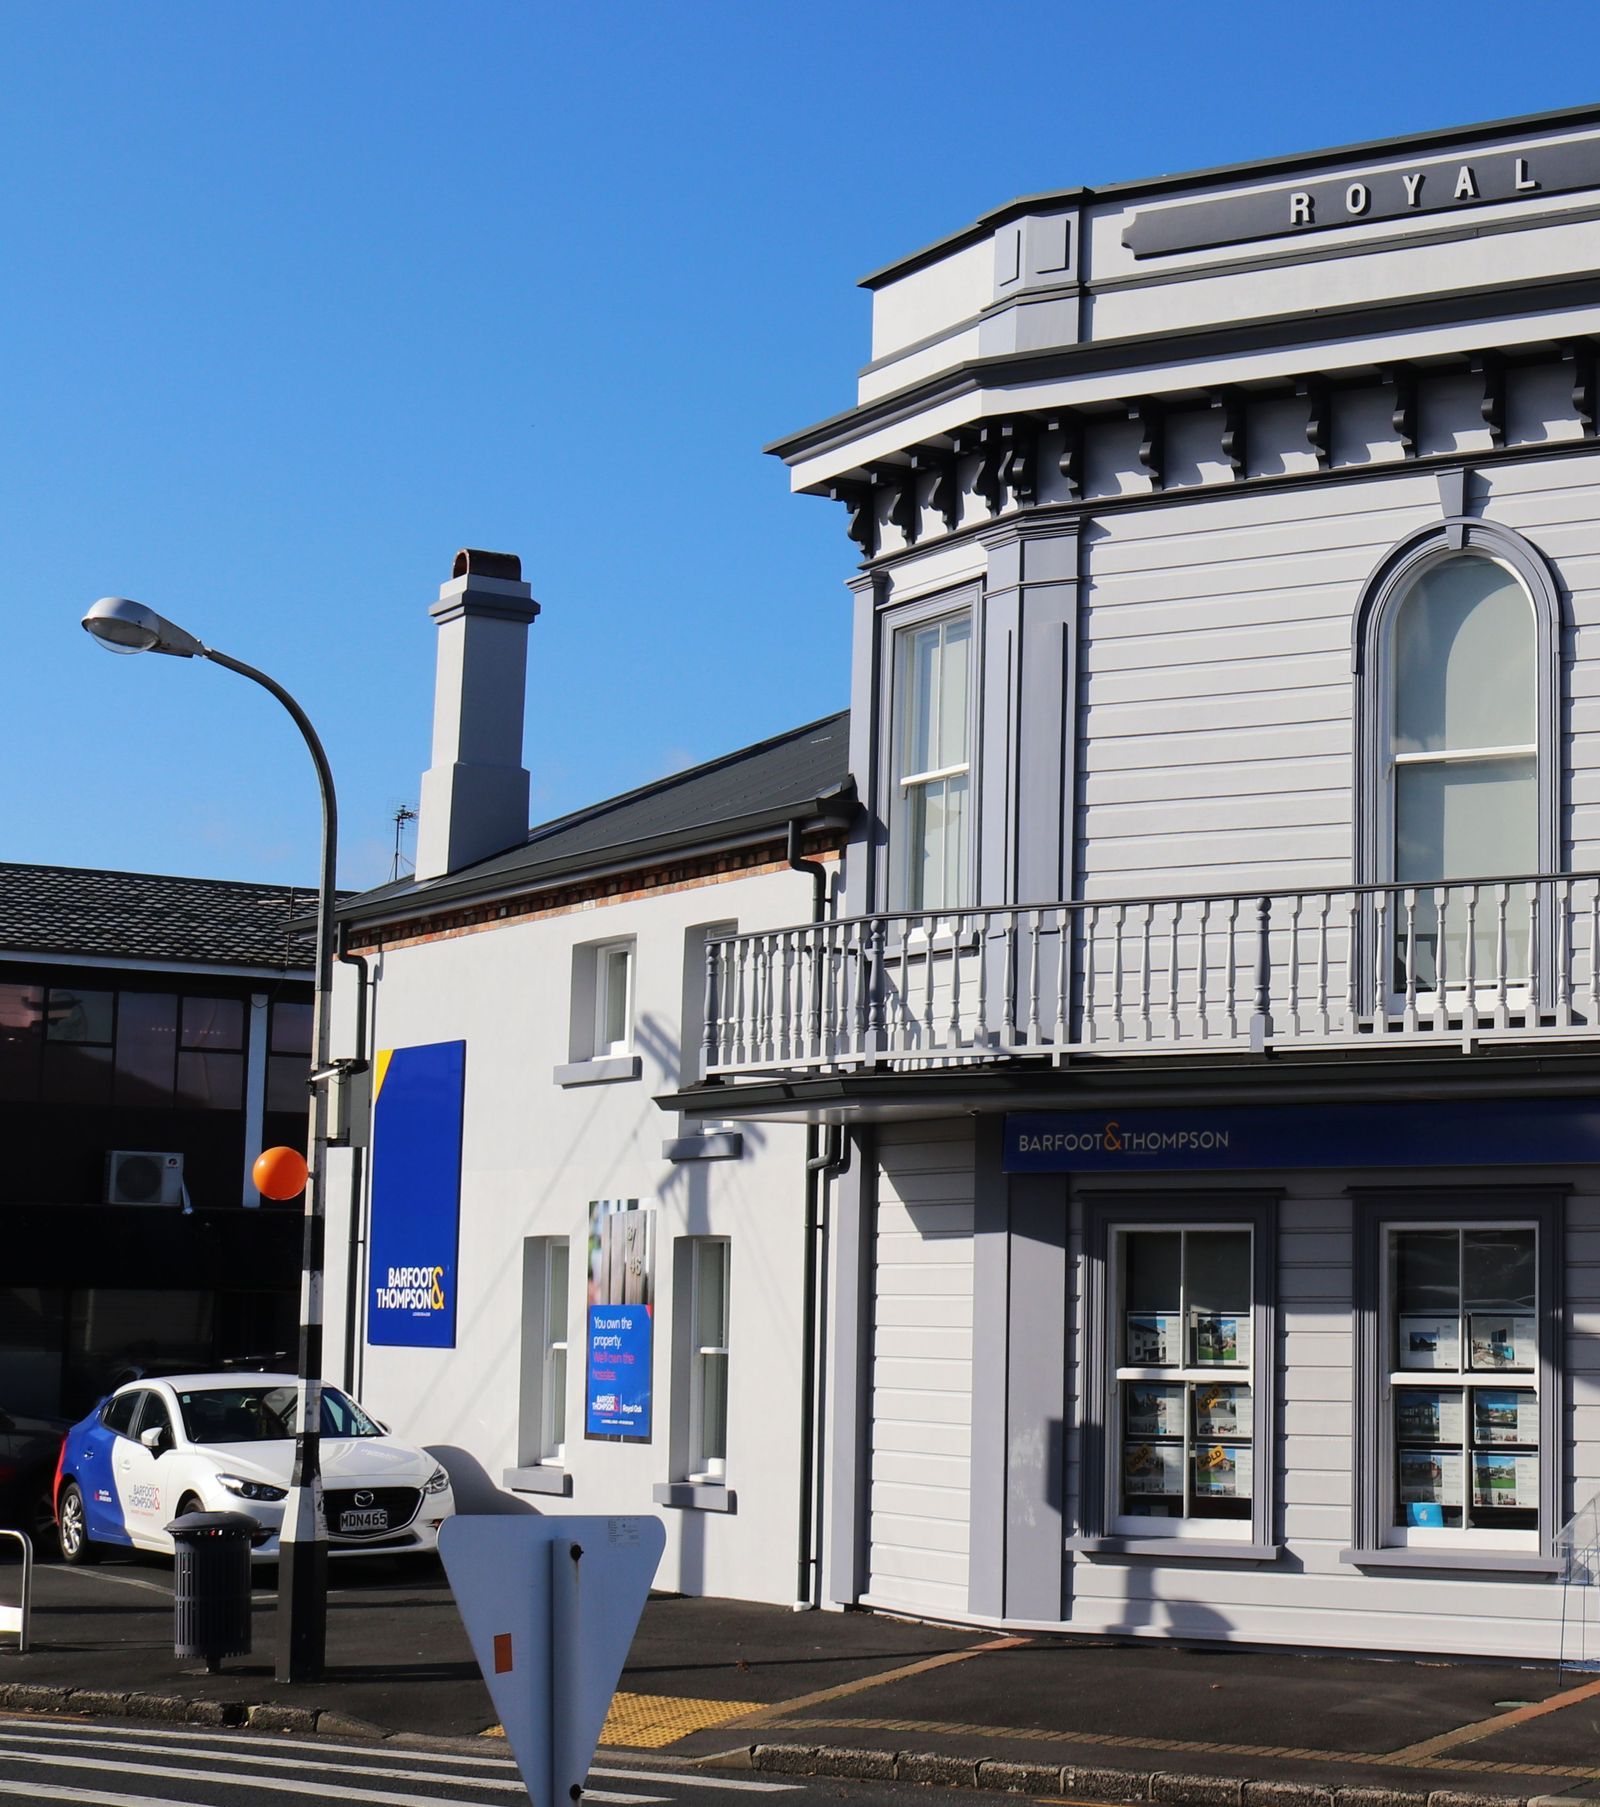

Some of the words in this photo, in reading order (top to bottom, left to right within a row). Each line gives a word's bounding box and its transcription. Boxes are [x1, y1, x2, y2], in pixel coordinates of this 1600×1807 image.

[1289, 158, 1540, 225] ROYAL
[388, 1266, 434, 1288] BARFOOT
[376, 1288, 432, 1310] THOMPSON
[594, 1317, 606, 1329] You
[607, 1320, 620, 1329] own
[621, 1317, 632, 1329] the
[593, 1335, 622, 1349] property.
[592, 1402, 614, 1411] THOMPSON
[622, 1404, 634, 1414] Royal
[634, 1404, 642, 1413] Oak
[1200, 1449, 1222, 1467] SOLD
[133, 1485, 155, 1497] BARFOOT
[129, 1494, 154, 1509] THOMPSON
[341, 1512, 387, 1527] MDN465
